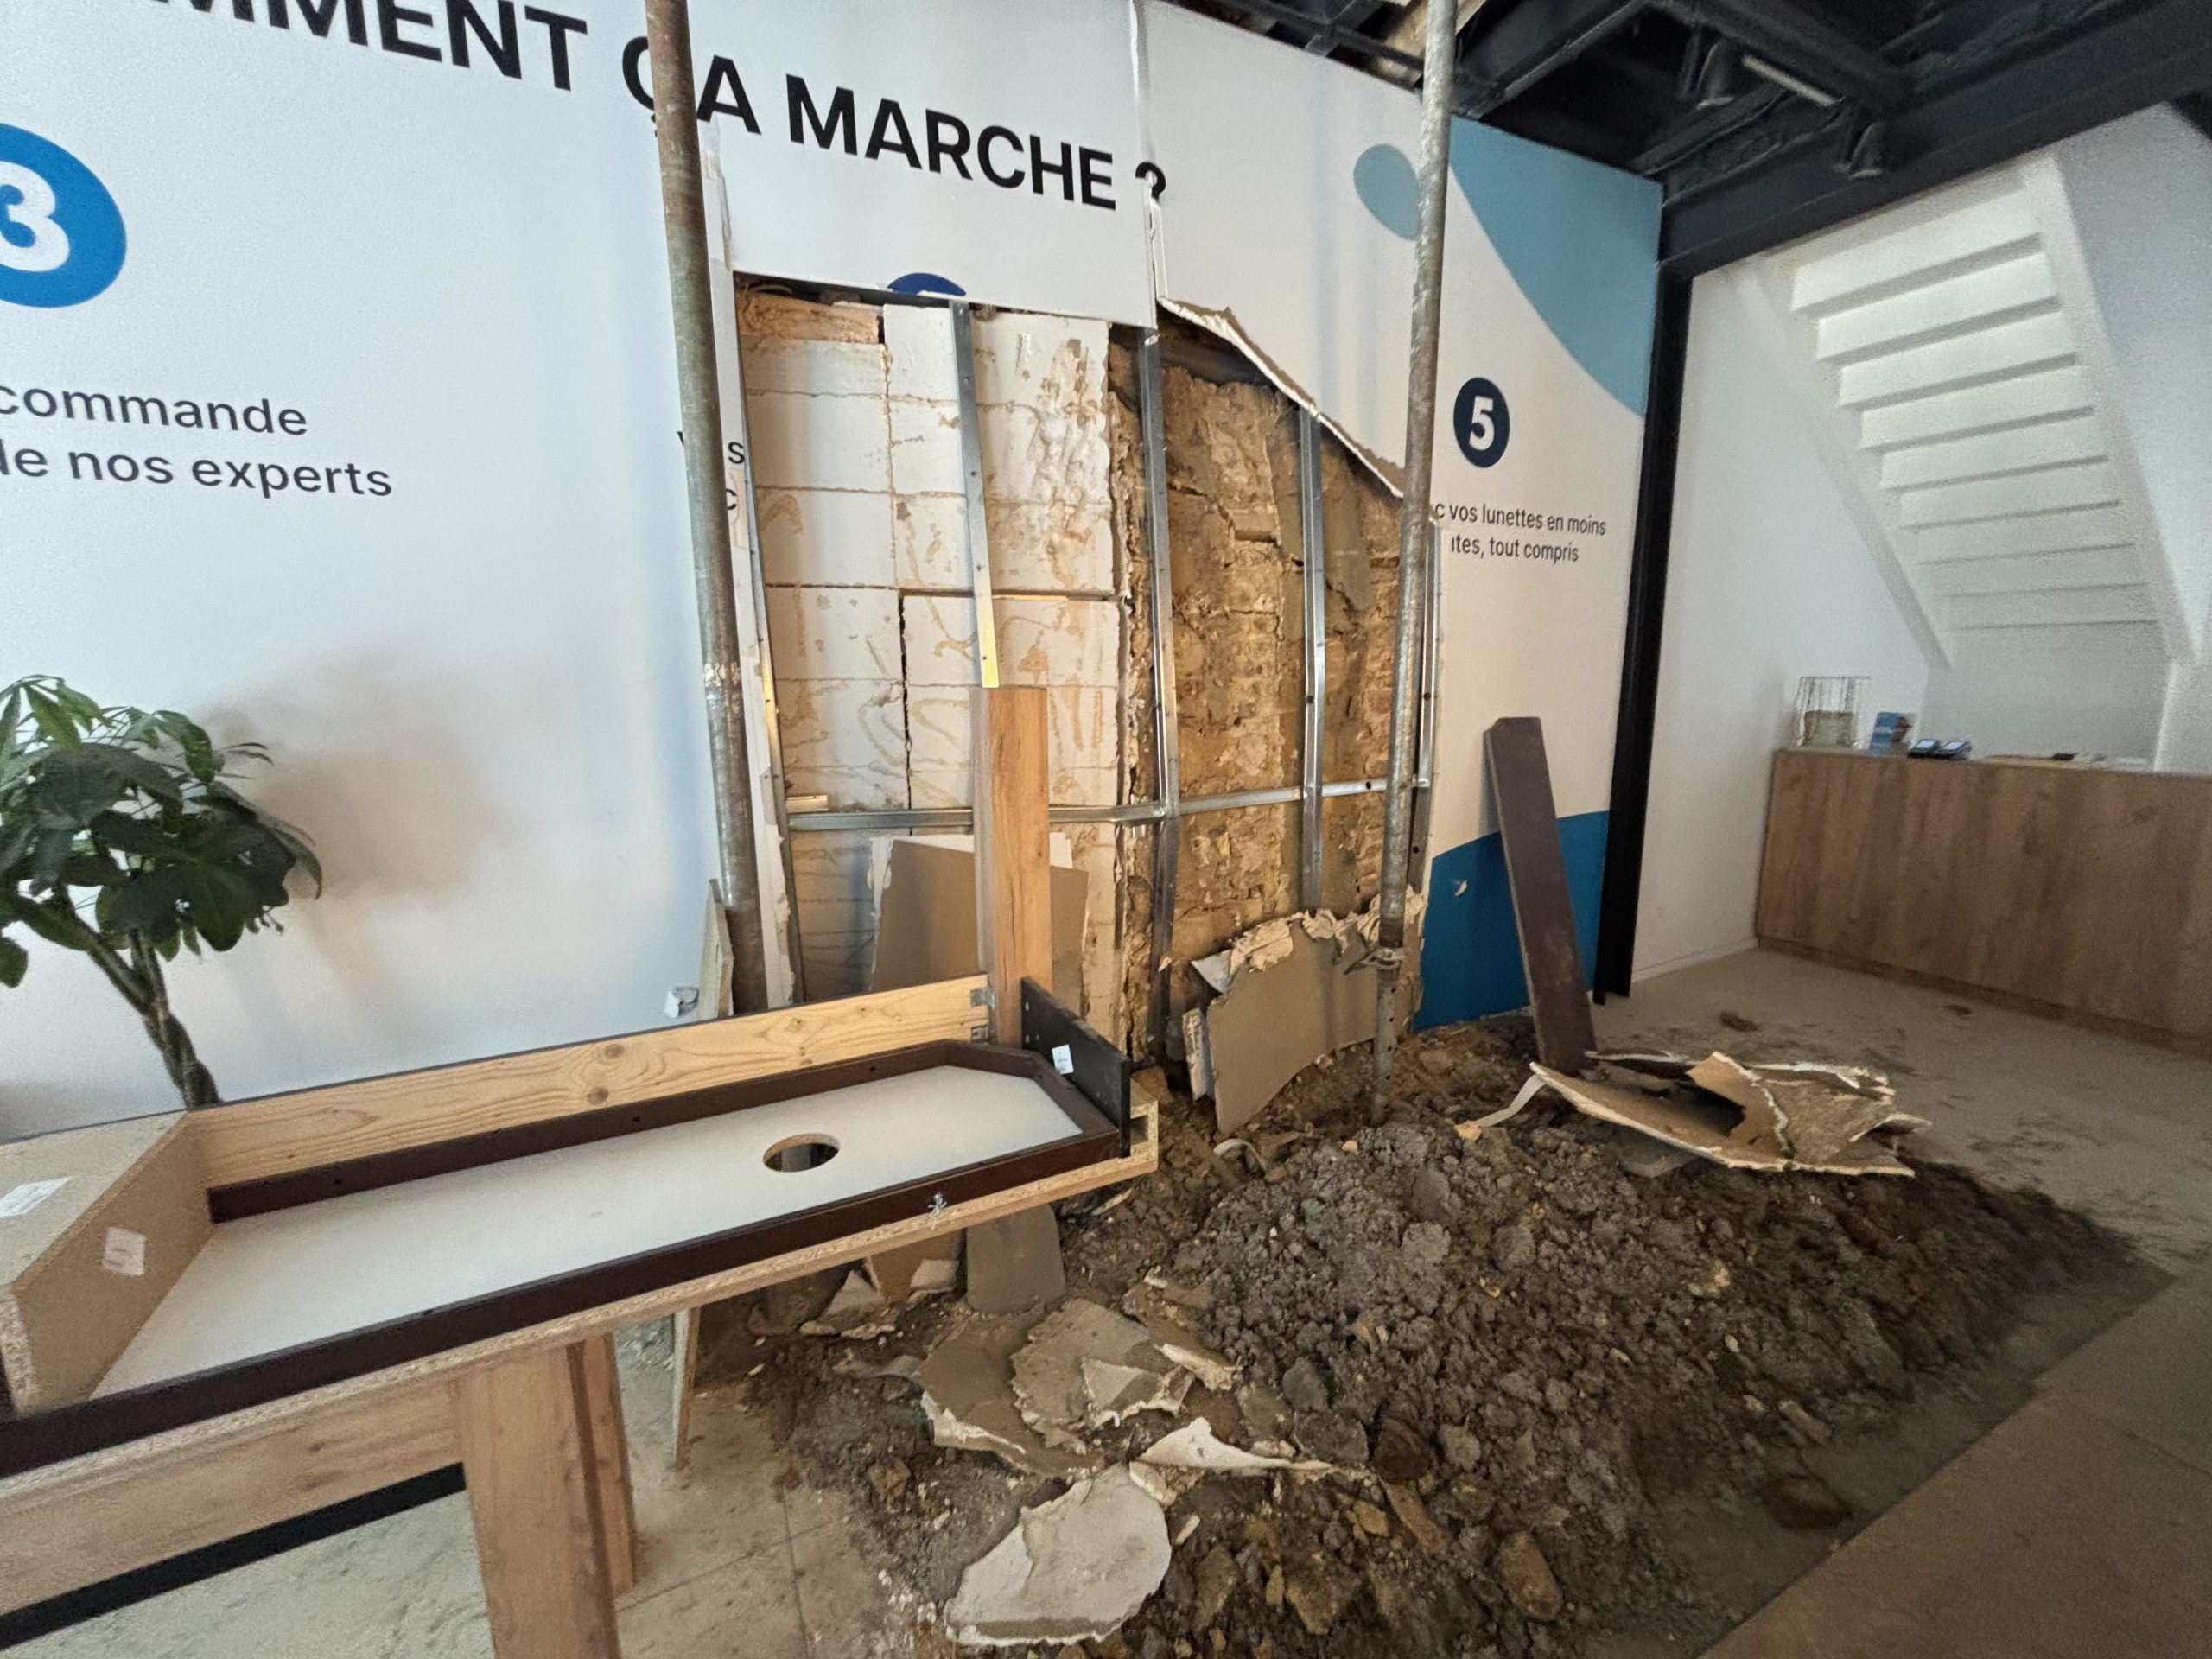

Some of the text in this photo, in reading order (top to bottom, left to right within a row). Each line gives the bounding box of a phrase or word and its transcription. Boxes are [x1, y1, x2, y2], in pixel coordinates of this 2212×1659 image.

[785, 73, 1117, 211] MARCHE
[0, 160, 71, 273] 3
[1469, 395, 1496, 452] 5
[68, 451, 175, 485] nos
[191, 459, 393, 500] experts
[1448, 504, 1478, 523] vos
[1482, 503, 1544, 530] lunettes
[1547, 514, 1565, 532] en
[1567, 514, 1607, 537] moins
[1489, 537, 1521, 558] tout
[1523, 543, 1580, 566] compris
